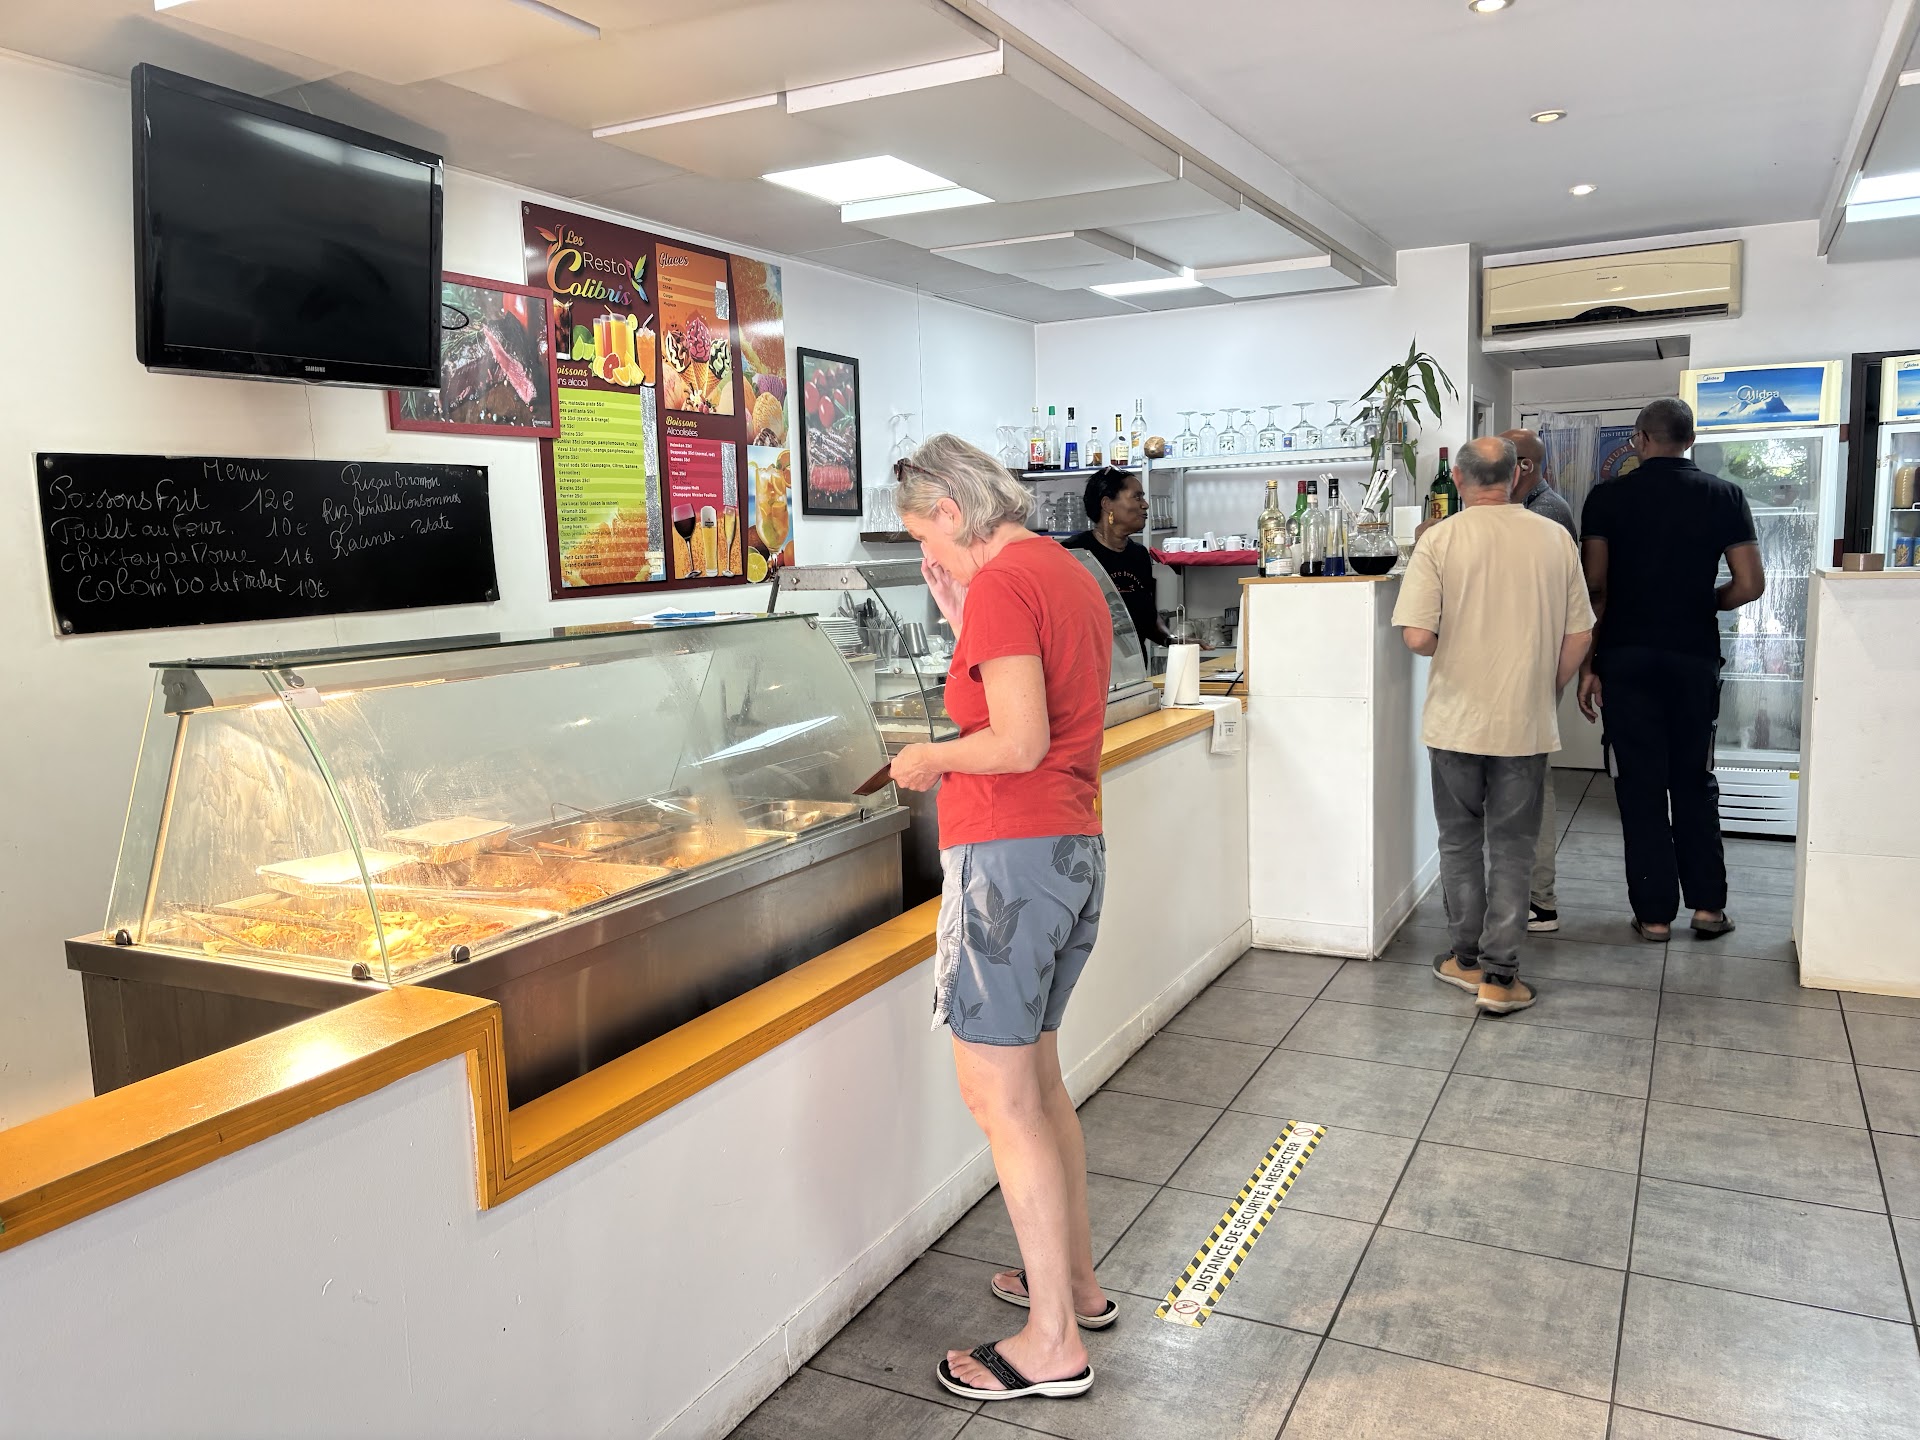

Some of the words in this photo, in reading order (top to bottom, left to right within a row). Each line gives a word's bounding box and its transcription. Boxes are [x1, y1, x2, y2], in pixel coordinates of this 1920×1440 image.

[565, 230, 584, 246] Les
[583, 252, 627, 276] Resto
[658, 252, 690, 268] Glaces
[547, 249, 632, 306] Colibris
[567, 378, 588, 387] alcool
[1736, 385, 1780, 402] Midea
[666, 416, 697, 428] Boissons
[667, 427, 698, 437] Alcoolisées
[204, 459, 270, 482] Menu
[1192, 1244, 1233, 1292] DISTANCE
[1224, 1230, 1243, 1244] DE
[1234, 1190, 1269, 1231] SÉCURITÉ
[1265, 1142, 1301, 1183] RESPECTER
